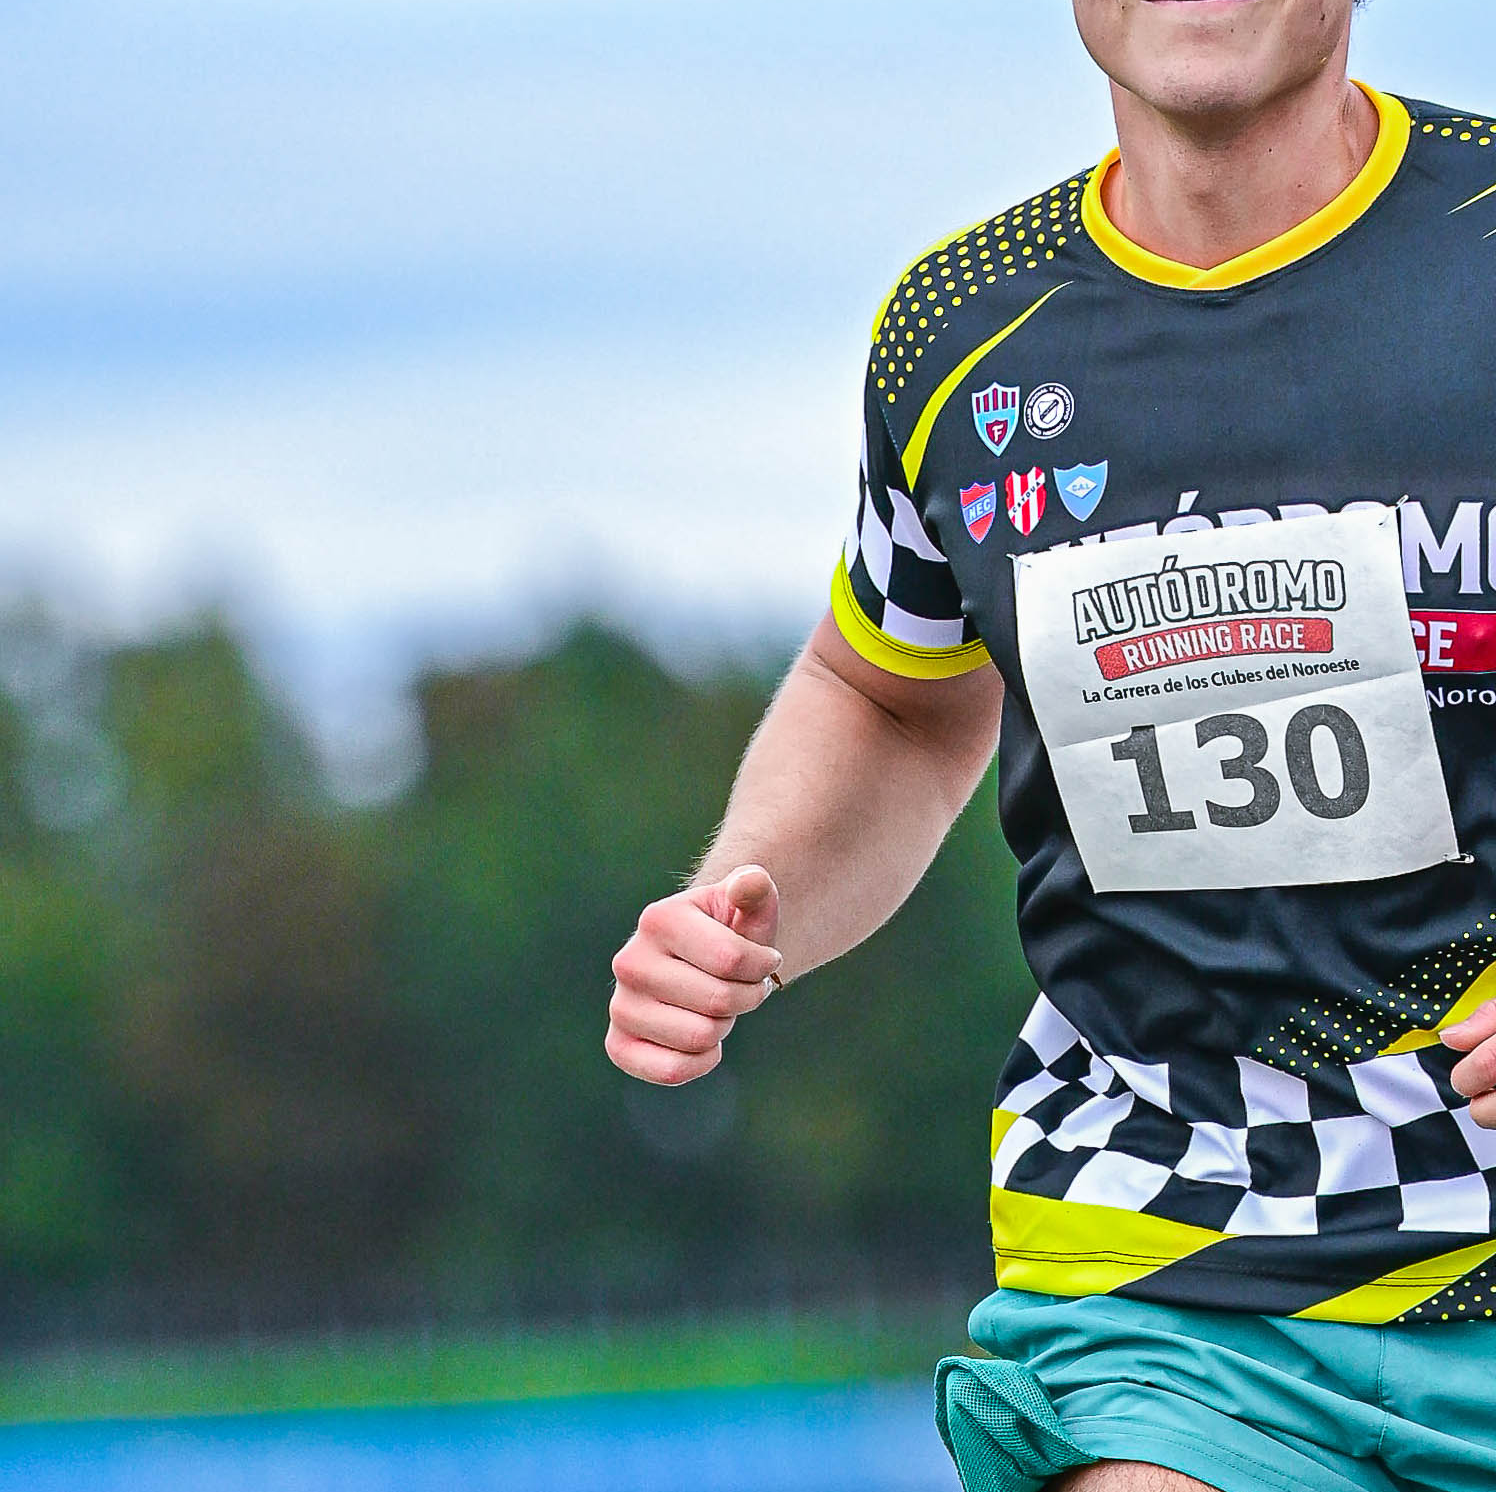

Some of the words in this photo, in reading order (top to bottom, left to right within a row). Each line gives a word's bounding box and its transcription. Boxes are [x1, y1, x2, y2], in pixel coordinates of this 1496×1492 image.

[1072, 555, 1346, 644] AUTÓDROMO
[1082, 688, 1101, 704] La
[1103, 683, 1160, 701] Carrera
[1163, 677, 1183, 693] de
[1186, 673, 1209, 690] los
[1210, 668, 1263, 687] Clubes
[1265, 662, 1290, 680] del
[1292, 658, 1360, 677] Noroeste
[1120, 623, 1234, 673] RUNNING
[1240, 622, 1306, 654] RACE
[1109, 703, 1371, 835] 130
